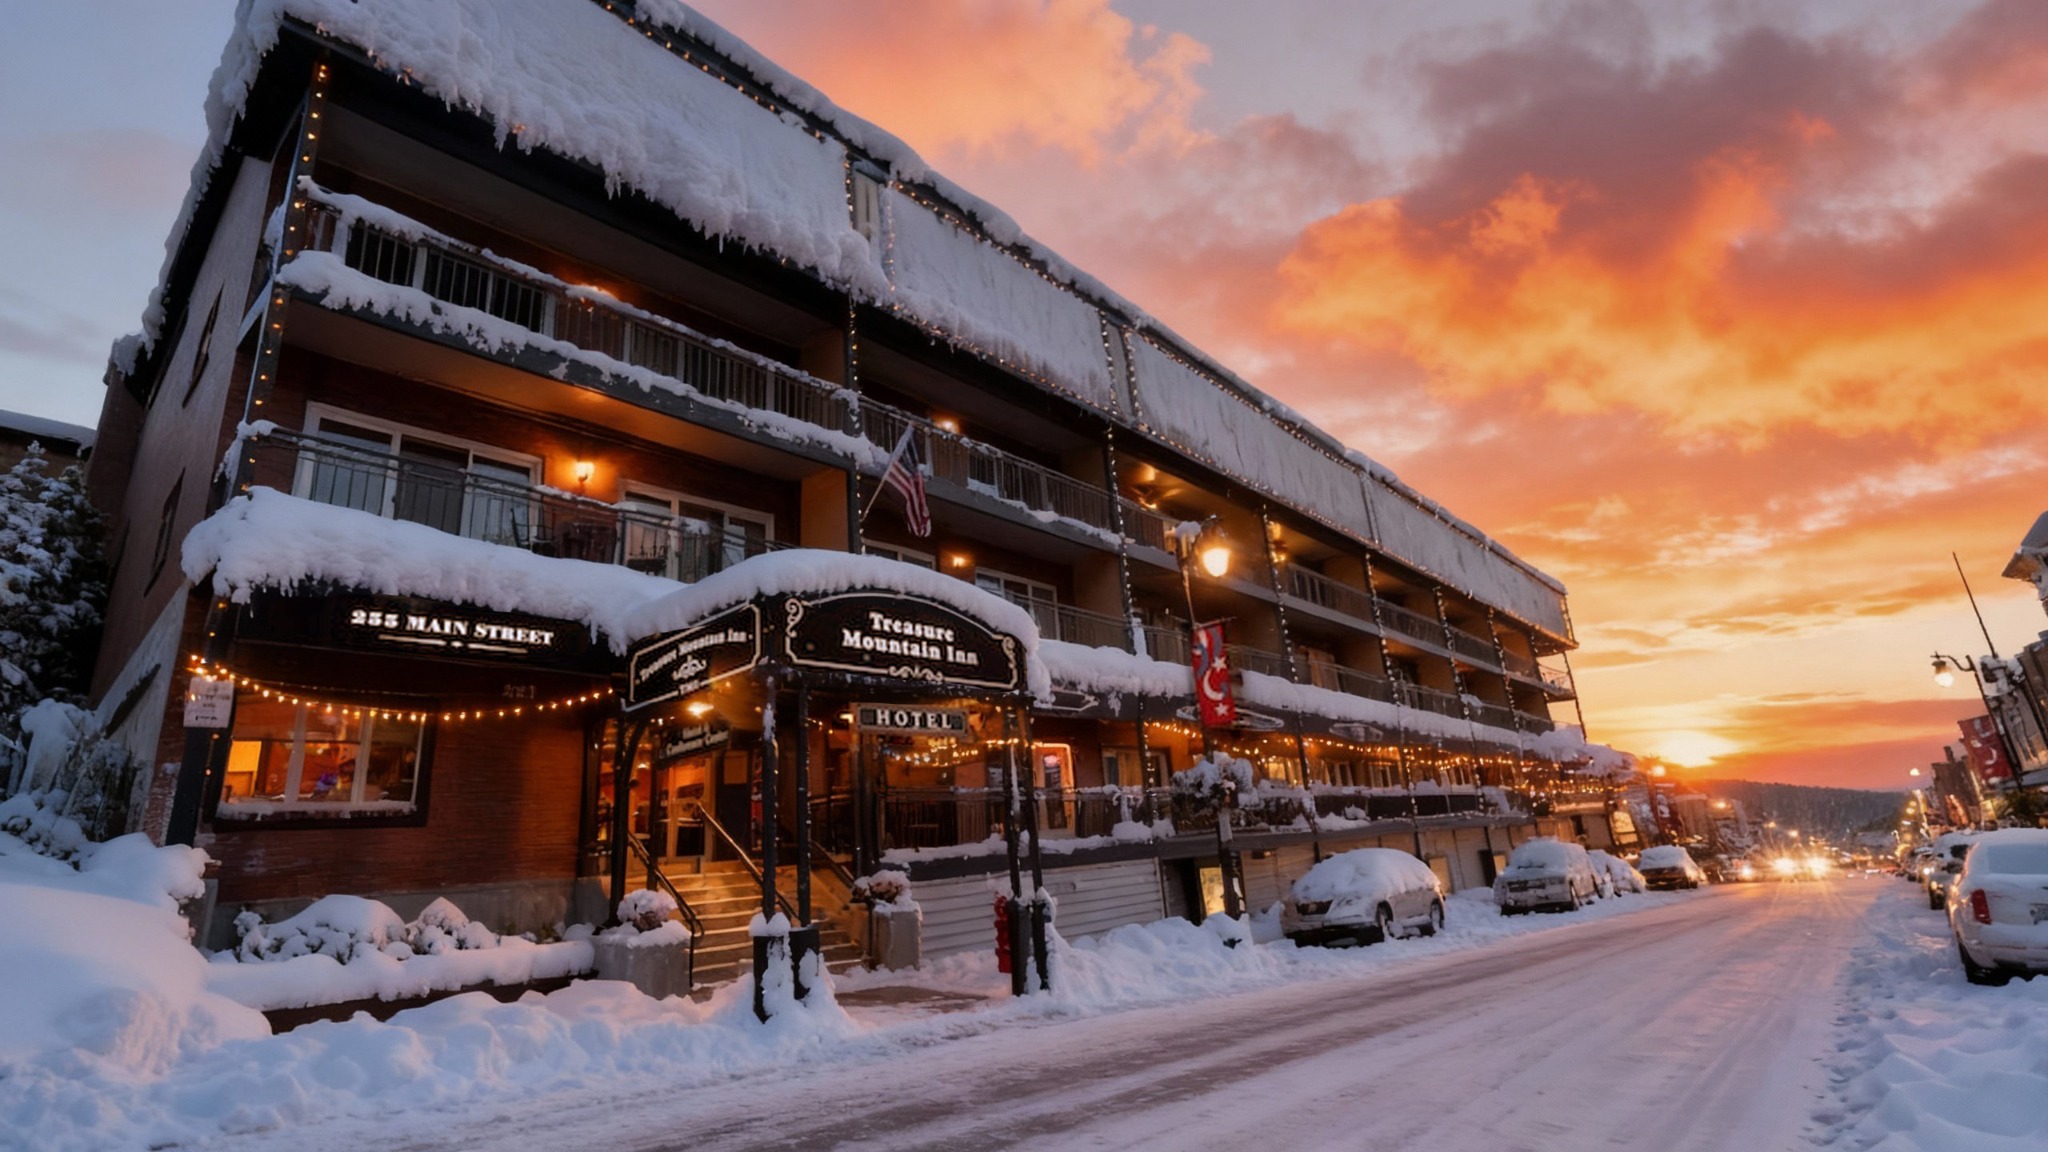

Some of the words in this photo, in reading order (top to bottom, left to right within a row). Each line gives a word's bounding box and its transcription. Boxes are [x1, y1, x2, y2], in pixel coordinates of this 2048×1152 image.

[406, 615, 469, 636] MAIN
[474, 623, 554, 645] STREET
[869, 611, 954, 641] Treasure
[842, 628, 941, 660] Mountain
[946, 645, 979, 665] Inn
[876, 709, 952, 728] HOTEL
